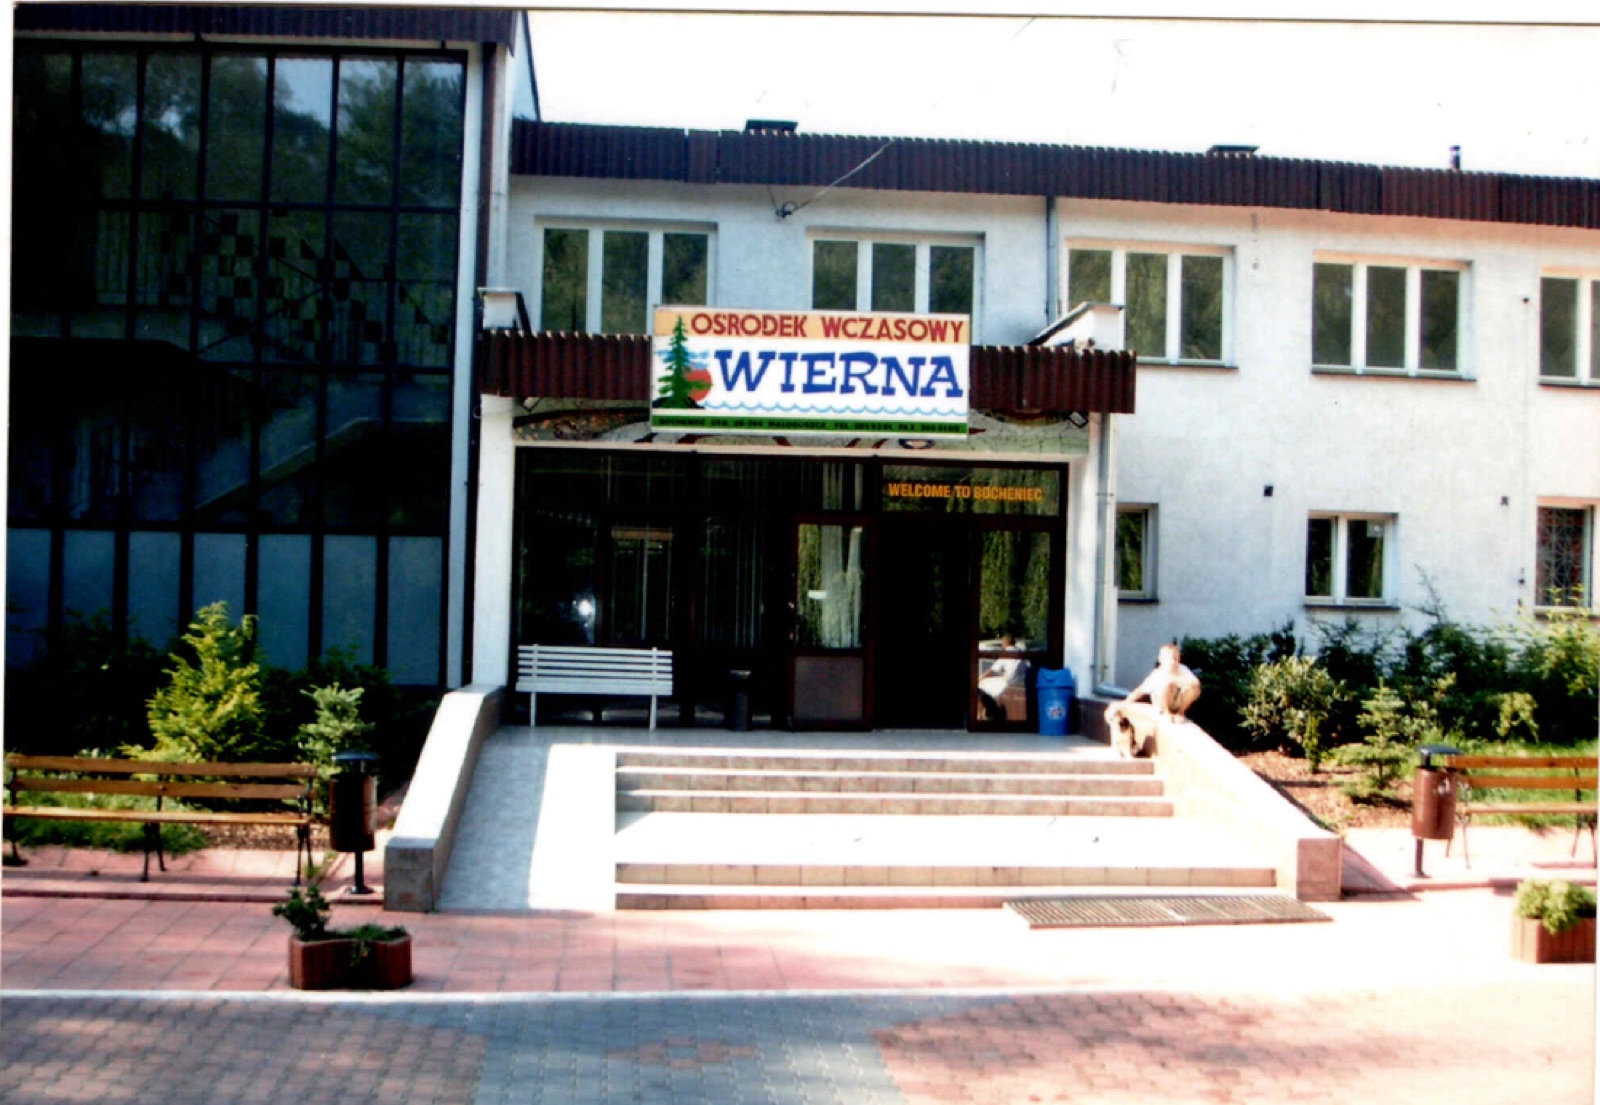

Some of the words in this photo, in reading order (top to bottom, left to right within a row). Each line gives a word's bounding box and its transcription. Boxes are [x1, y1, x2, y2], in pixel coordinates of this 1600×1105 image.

[821, 316, 964, 343] WCZASOWY
[714, 350, 963, 397] WIERNA
[888, 483, 951, 498] WELCOME
[955, 485, 970, 498] TO
[973, 486, 1043, 501] BOCHENIEC
